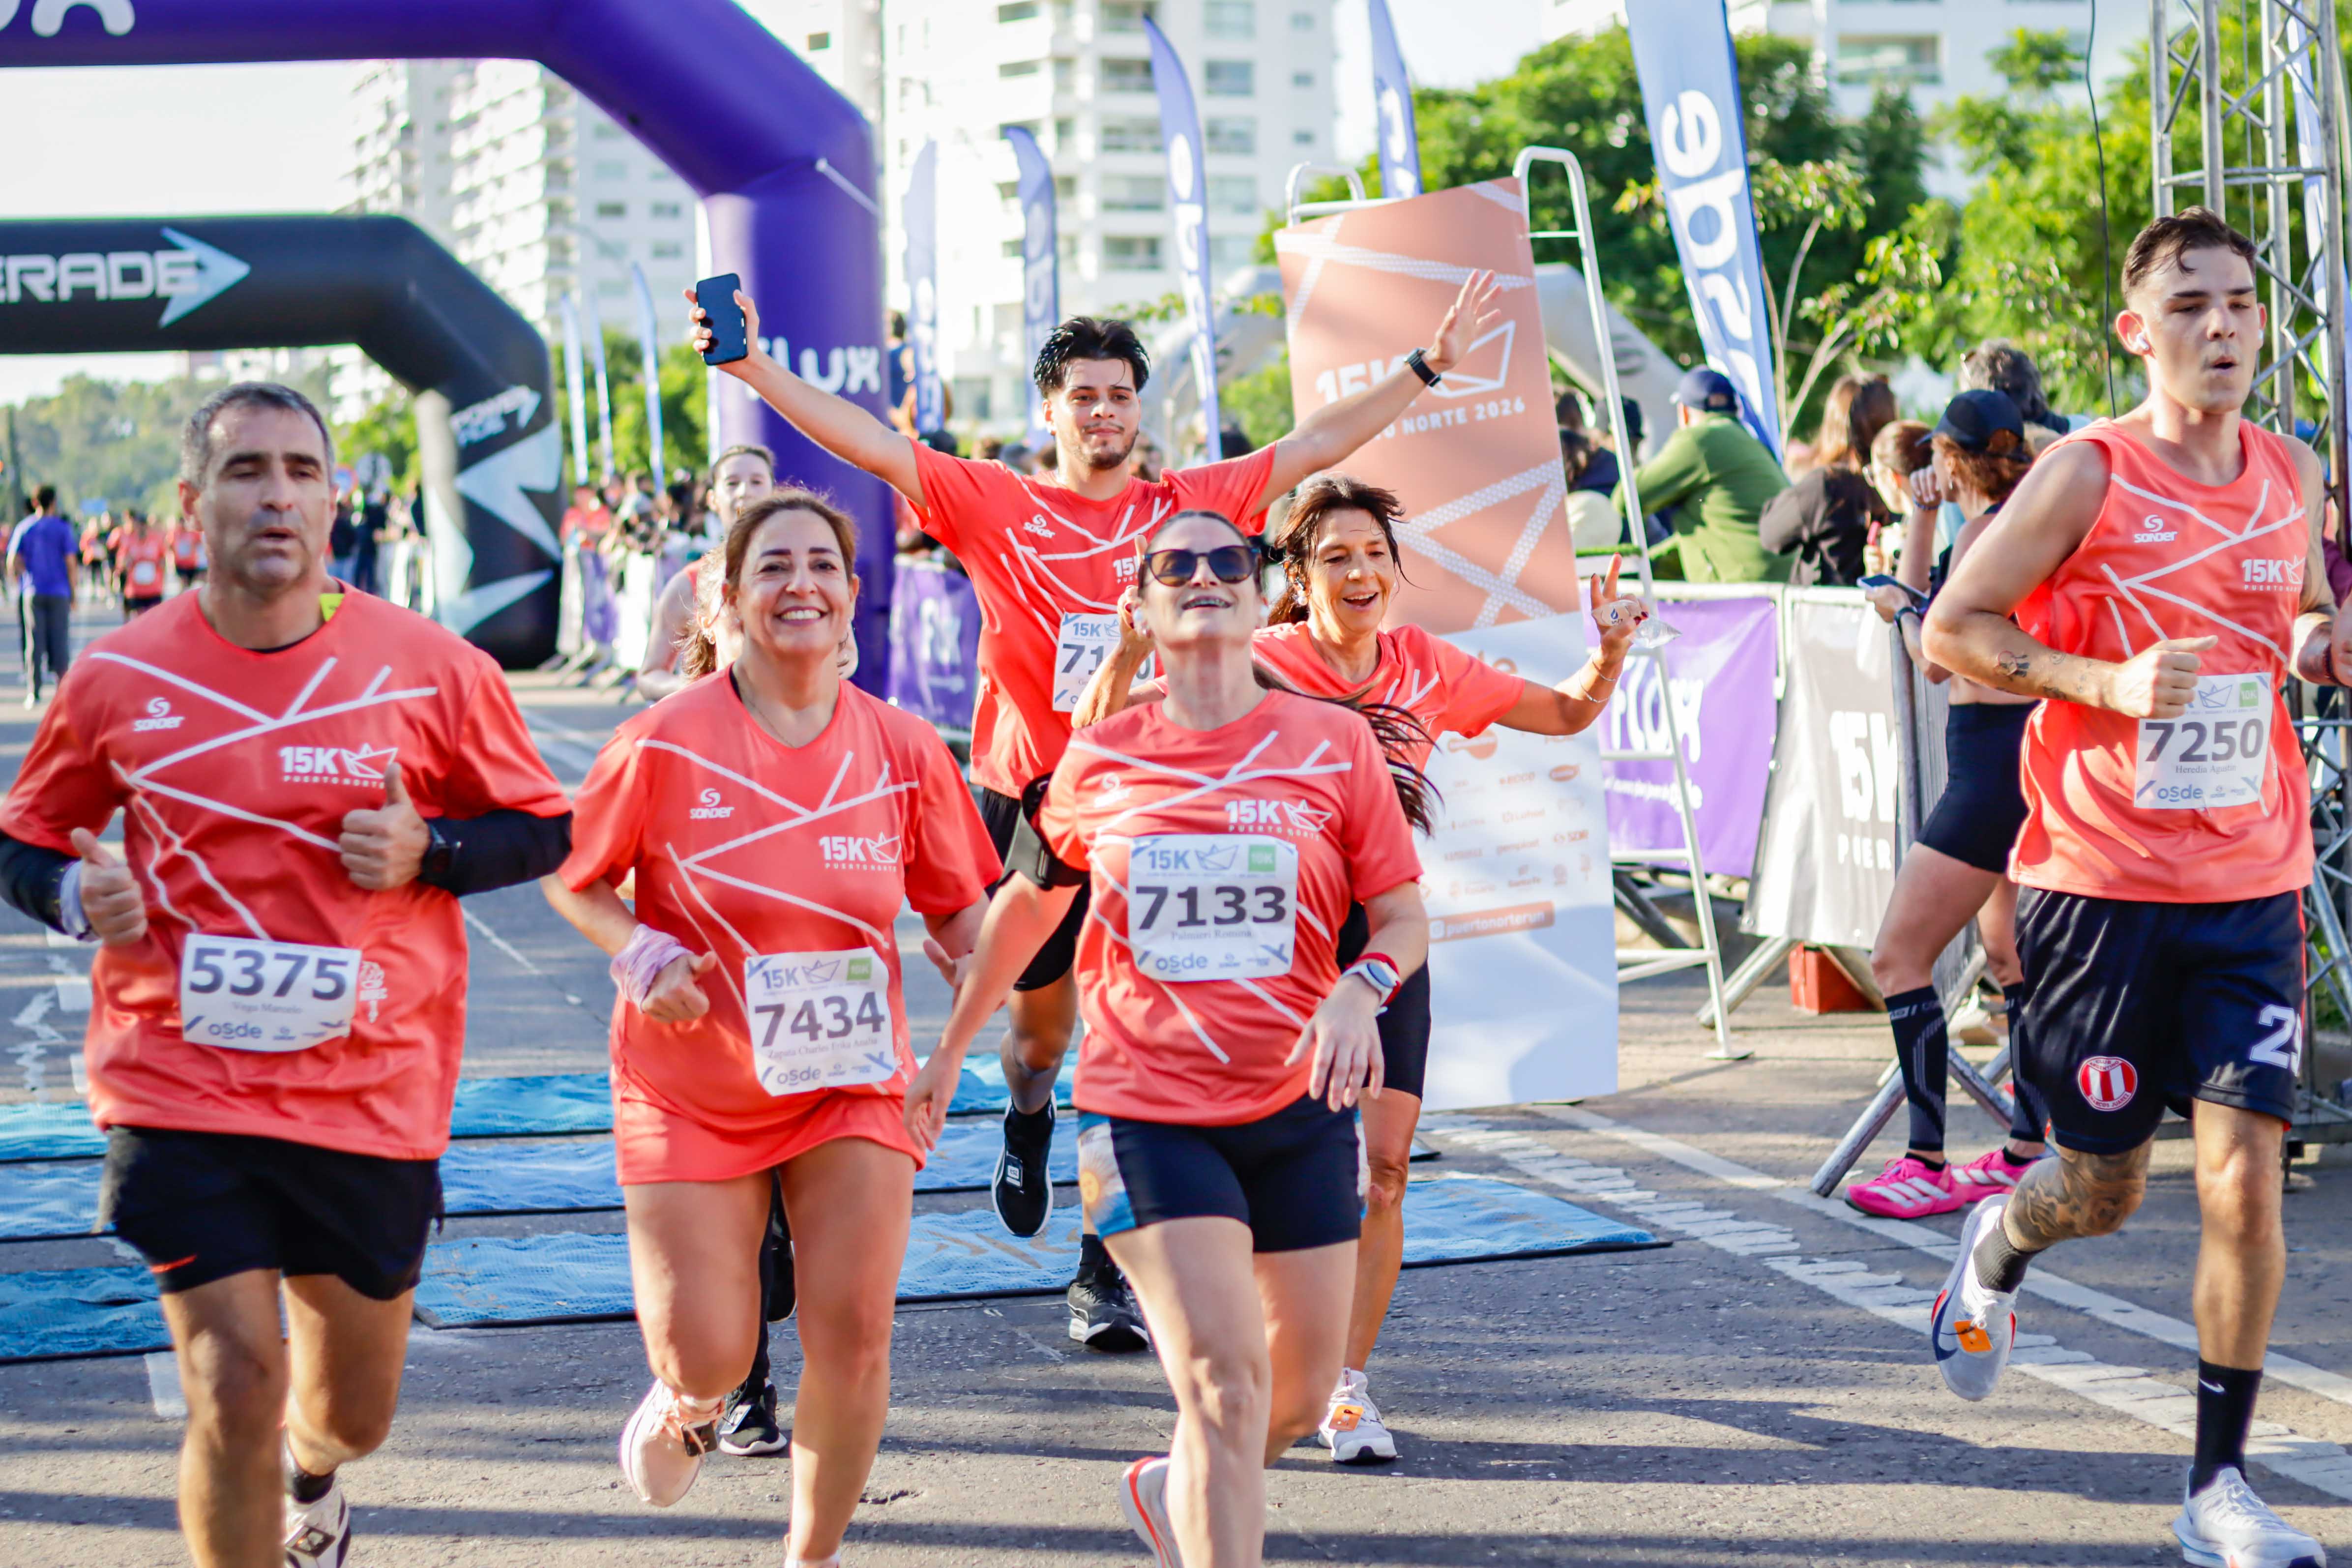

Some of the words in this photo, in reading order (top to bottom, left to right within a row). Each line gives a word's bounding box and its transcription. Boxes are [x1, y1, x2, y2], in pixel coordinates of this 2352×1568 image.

[0, 250, 198, 302] RADE
[745, 336, 882, 400] lux
[1402, 407, 1468, 436] NORTE
[1475, 396, 1526, 420] 2026
[2242, 559, 2284, 583] 15K
[1073, 622, 1102, 637] 15K
[2145, 718, 2264, 762] 7250
[280, 746, 338, 774] 15K
[2175, 765, 2207, 774] Heredia
[2157, 784, 2203, 802] osde
[1225, 799, 1281, 824] 15K
[819, 836, 866, 861] 15K
[1148, 850, 1190, 870] 15K
[1136, 886, 1286, 929] 7133
[1171, 931, 1211, 940] Palmieri
[1214, 929, 1251, 938] Romina
[1446, 912, 1545, 937] puertonorterun
[190, 947, 349, 1000] 5375
[1156, 952, 1208, 973] osde
[763, 967, 799, 989] 15K
[208, 1021, 262, 1039] osde
[755, 991, 885, 1047] 7434
[799, 1045, 828, 1056] Charles
[777, 1066, 821, 1086] osde
